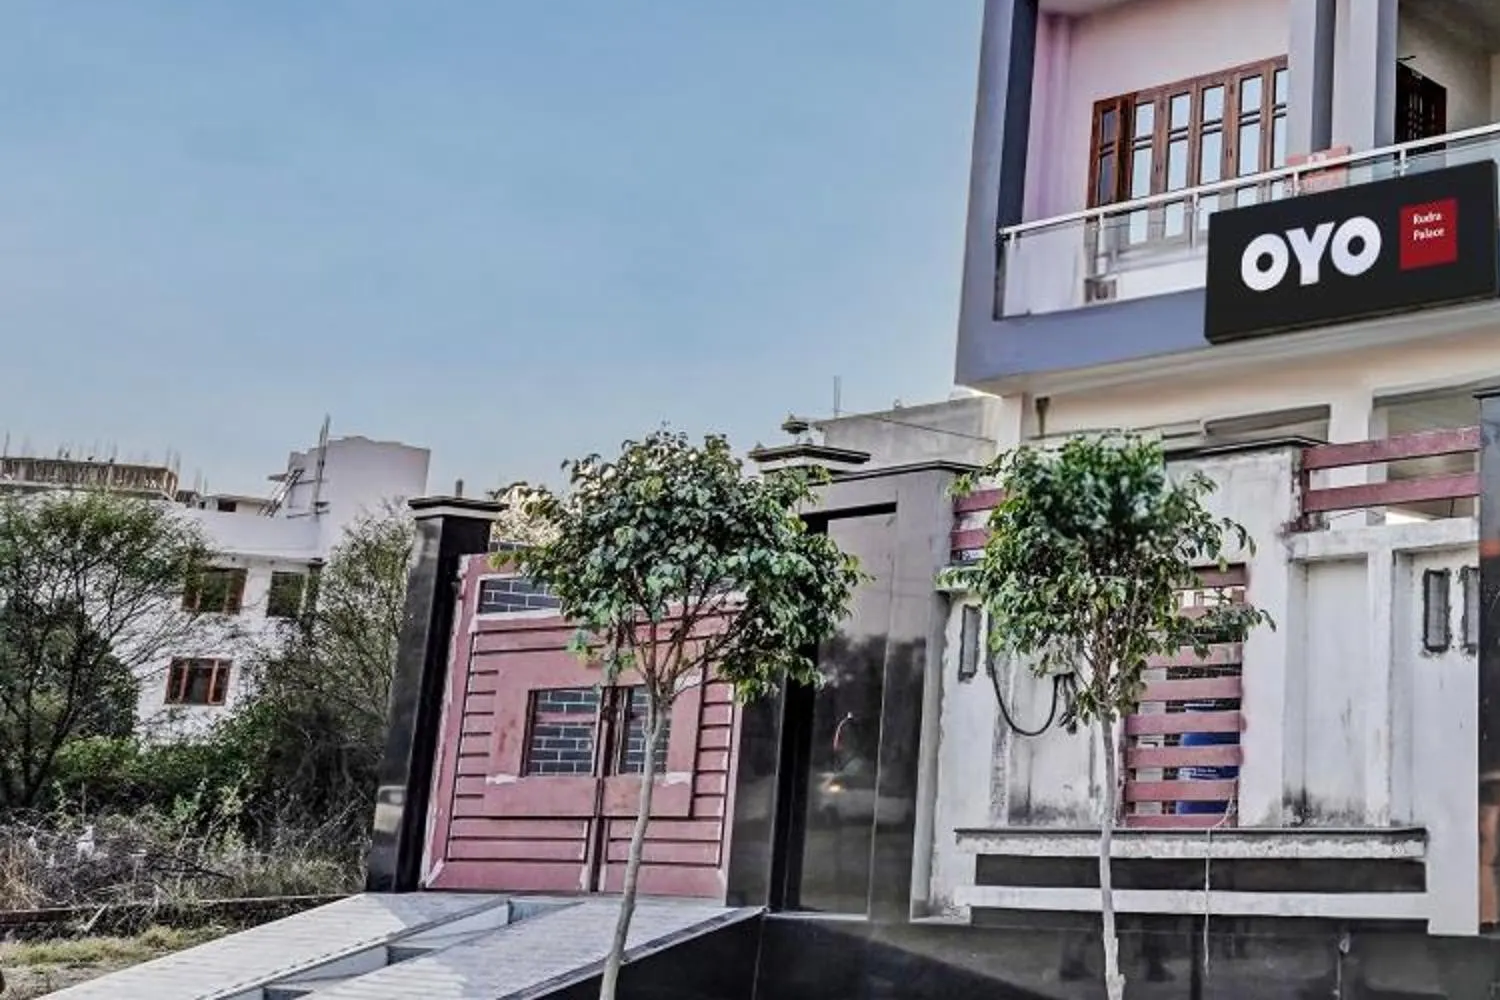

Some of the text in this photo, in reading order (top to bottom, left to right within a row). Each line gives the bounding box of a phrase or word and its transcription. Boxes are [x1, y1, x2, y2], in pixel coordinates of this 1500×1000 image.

[1412, 211, 1441, 225] Rudra
[1412, 226, 1445, 240] Palace
[1241, 216, 1382, 291] OYO
